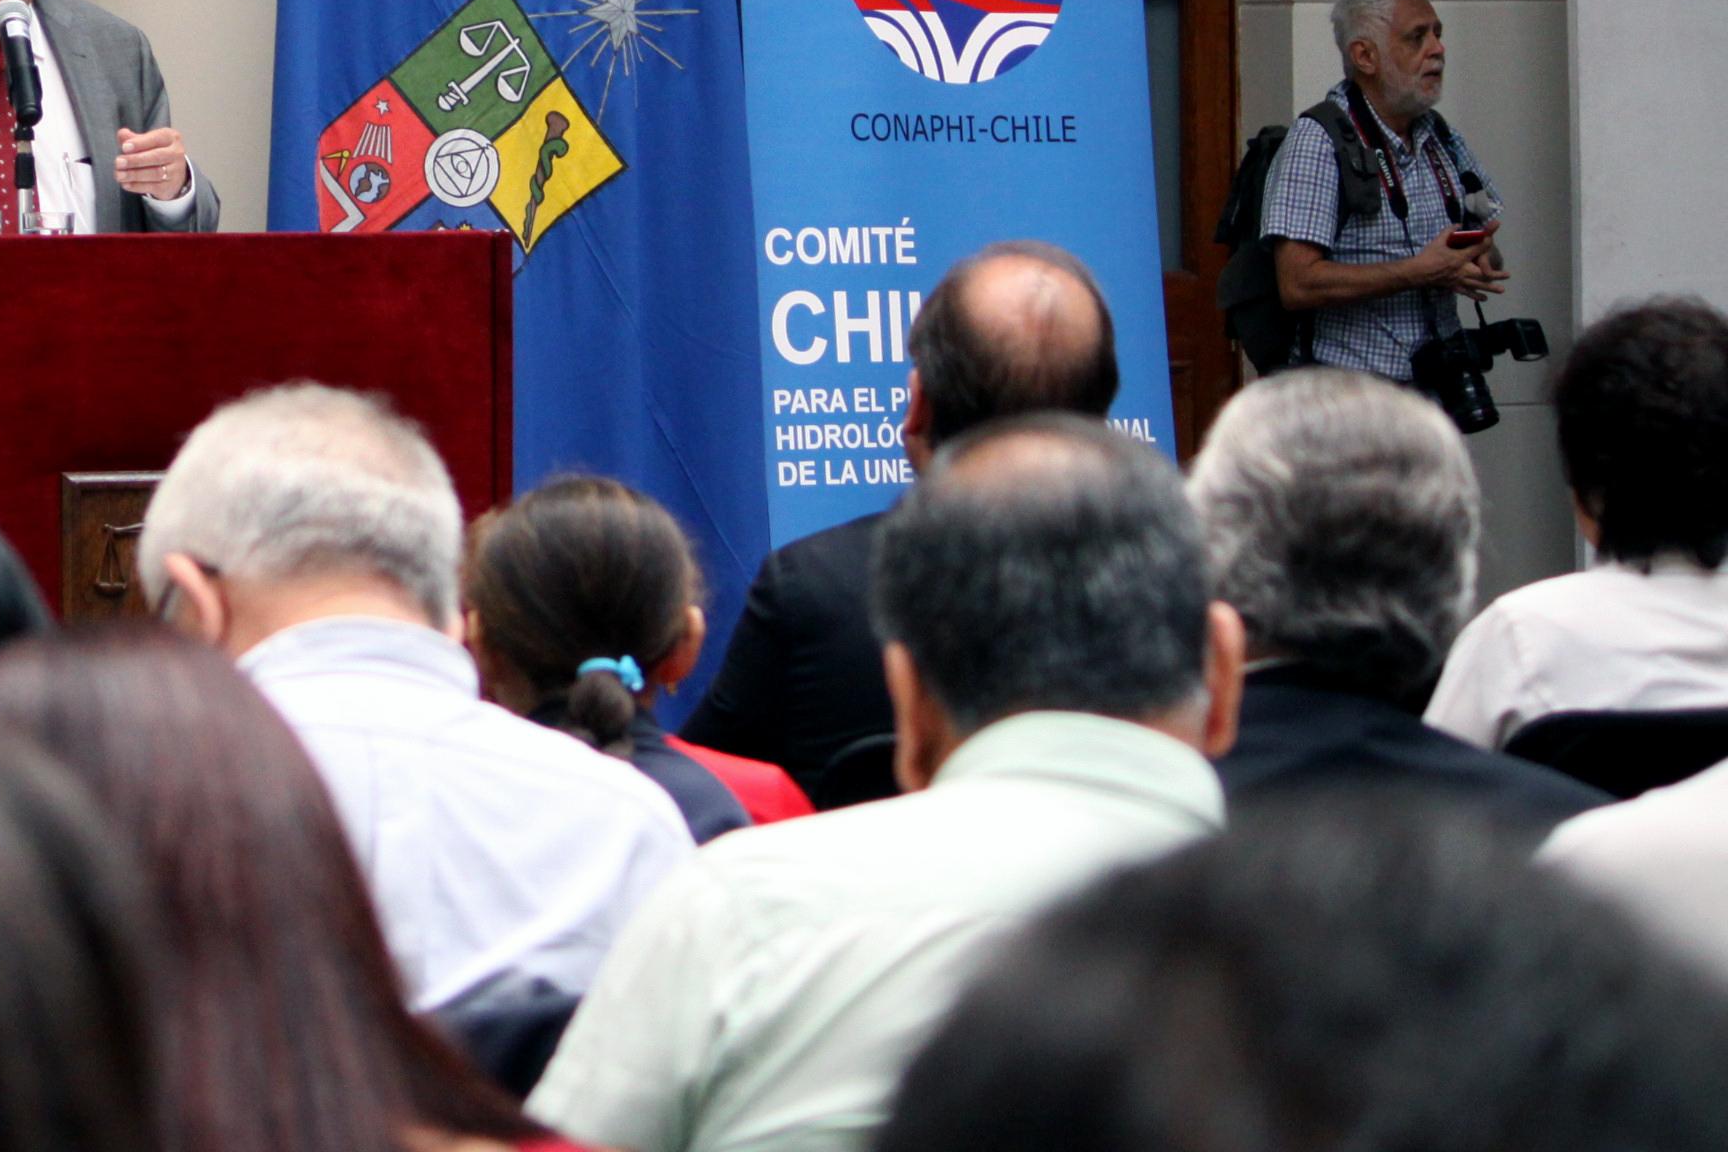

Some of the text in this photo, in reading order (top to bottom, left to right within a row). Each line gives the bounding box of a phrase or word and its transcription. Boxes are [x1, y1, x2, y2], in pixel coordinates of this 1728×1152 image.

[851, 113, 1076, 143] CONAPHI-CHILE
[765, 217, 917, 265] COMITÉ
[774, 388, 847, 414] PARA
[854, 388, 884, 413] EL
[1105, 418, 1156, 442] NAL
[778, 460, 816, 487] DE
[825, 460, 858, 484] LA
